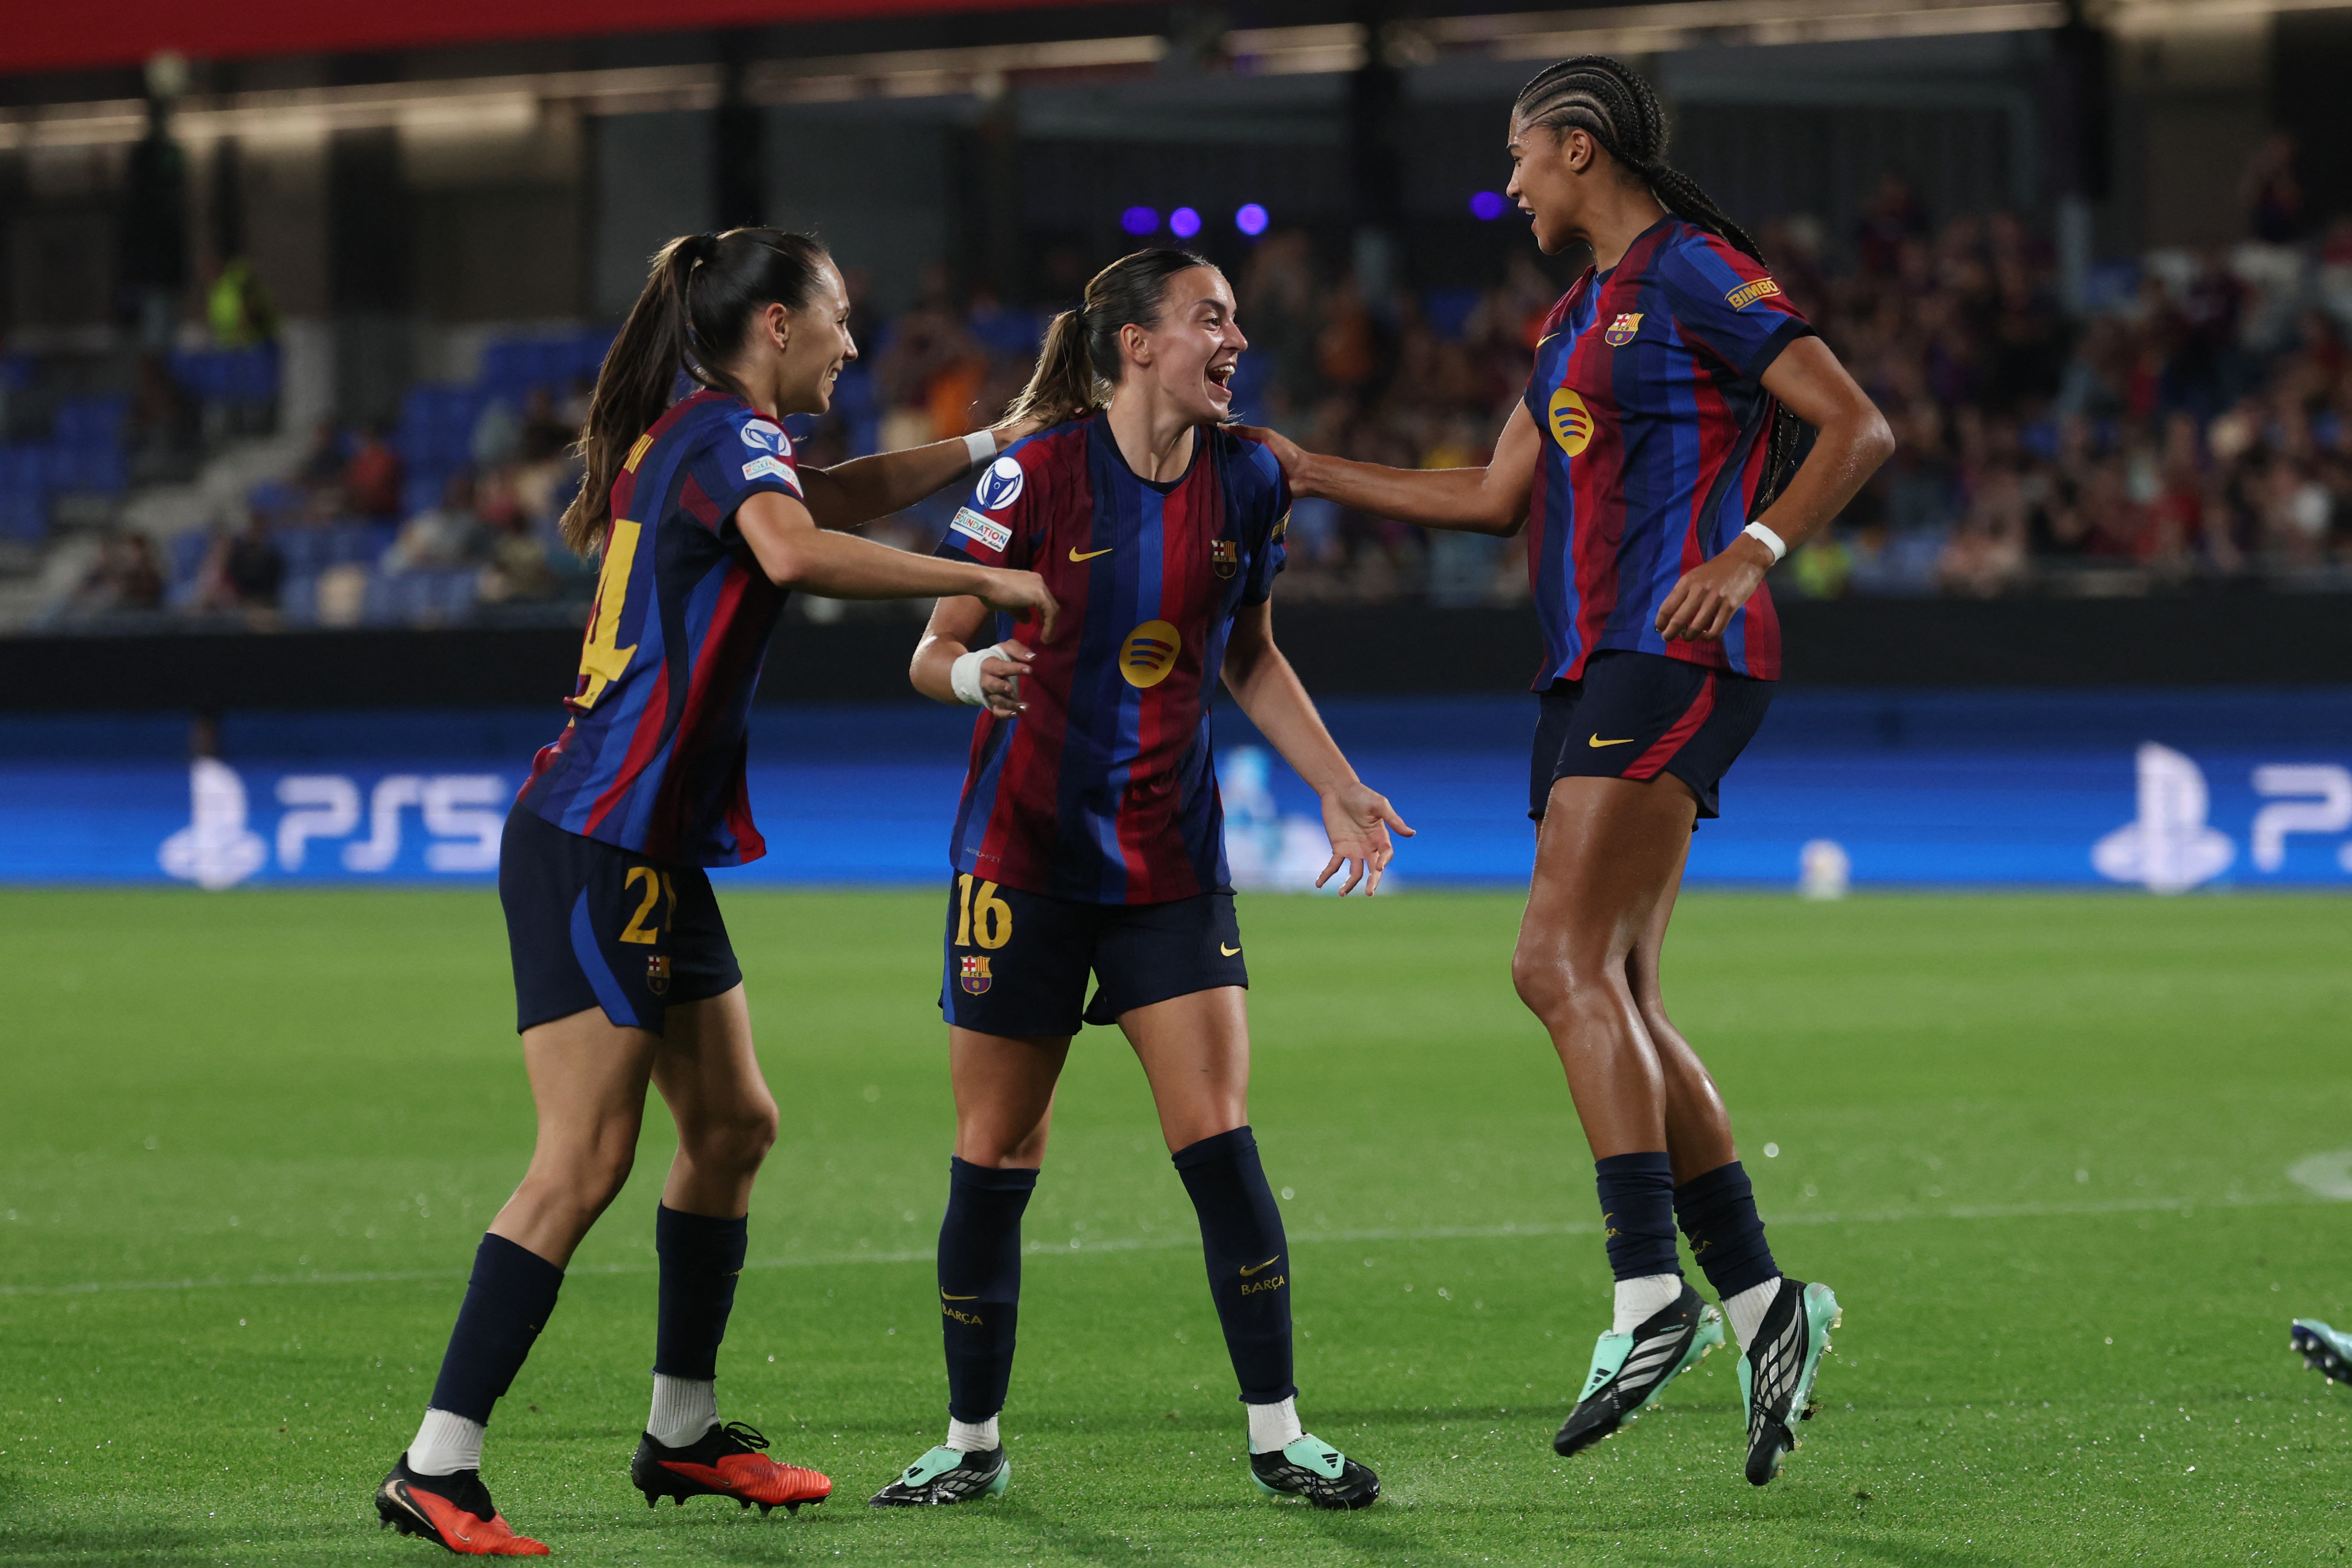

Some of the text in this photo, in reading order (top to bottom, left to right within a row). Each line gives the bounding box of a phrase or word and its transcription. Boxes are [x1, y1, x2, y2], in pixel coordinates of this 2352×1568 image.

[1728, 280, 1779, 309] BIMBO
[955, 514, 1007, 544] FOUNDATION
[987, 541, 1002, 550] children
[274, 774, 507, 872] PS5
[954, 873, 1013, 950] 16
[1241, 1274, 1285, 1296] BARÇA
